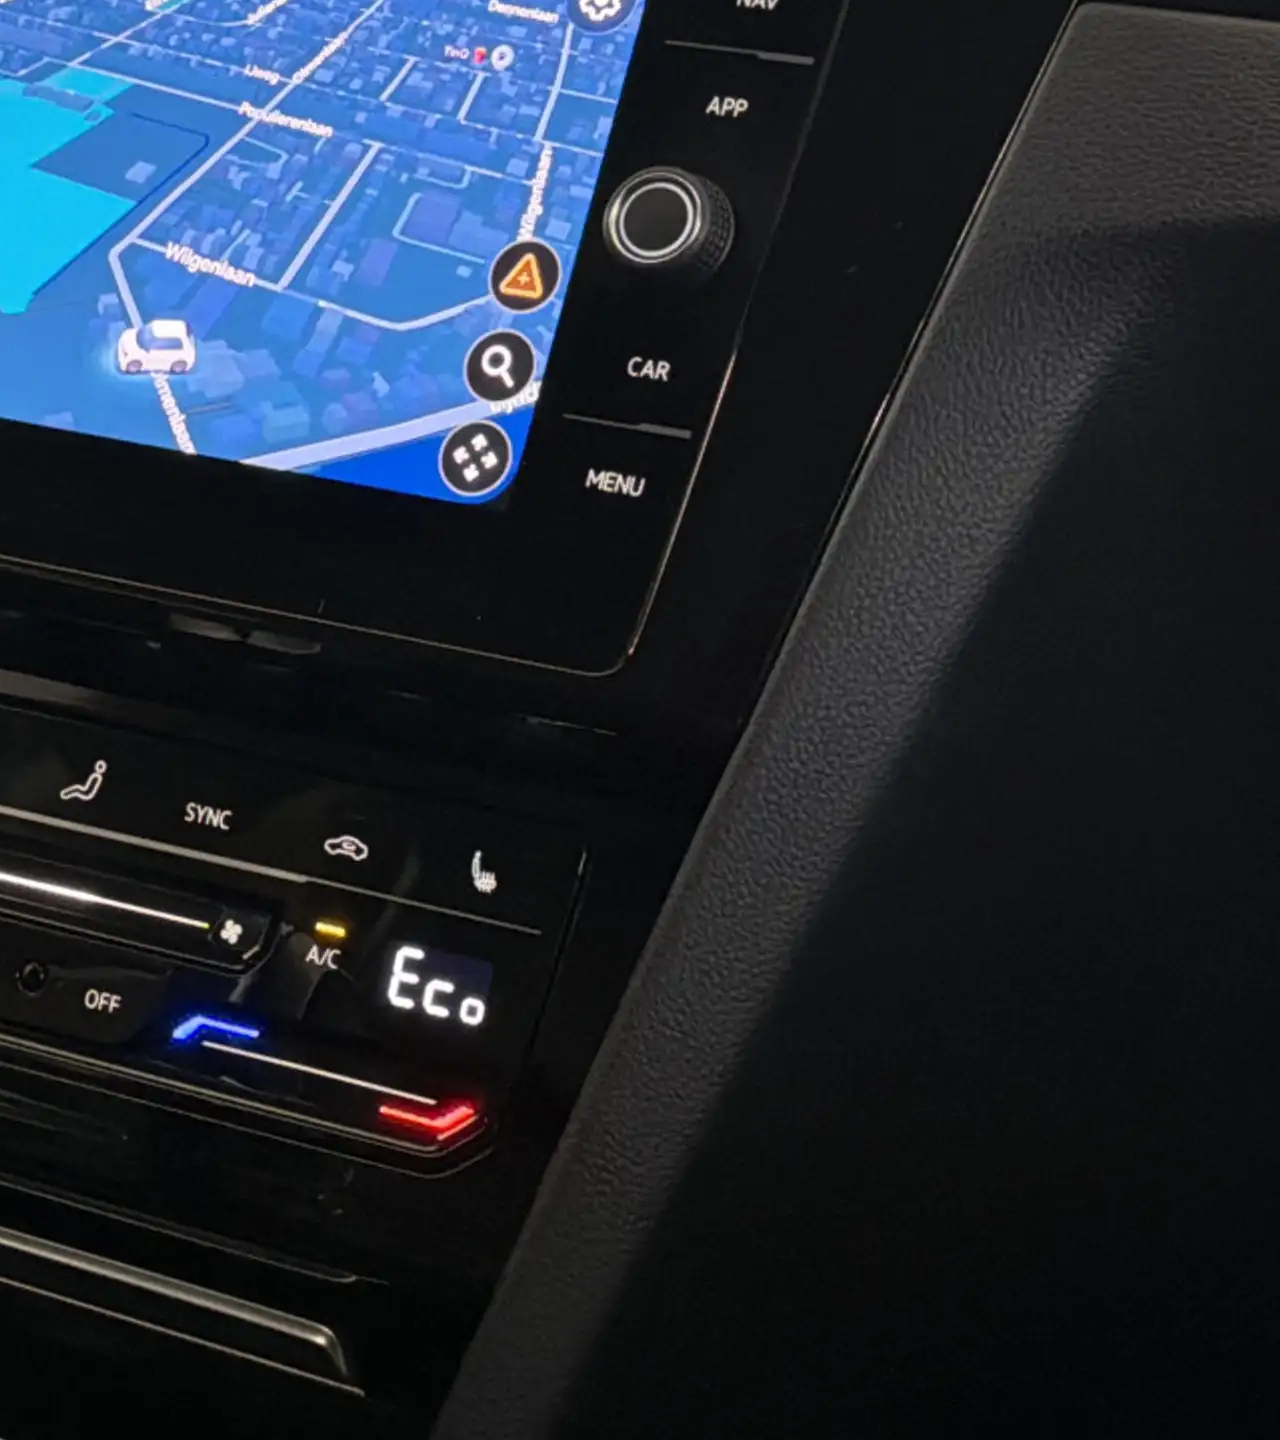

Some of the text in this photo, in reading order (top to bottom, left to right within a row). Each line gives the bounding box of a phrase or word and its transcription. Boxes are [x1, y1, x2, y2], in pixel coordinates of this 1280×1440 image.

[705, 95, 749, 119] APP
[165, 241, 256, 288] Wilgenlaan
[627, 357, 671, 383] CAR
[585, 468, 646, 498] MENU
[184, 800, 233, 832] SYNC
[305, 945, 340, 971] A/C
[83, 988, 122, 1015] OFF
